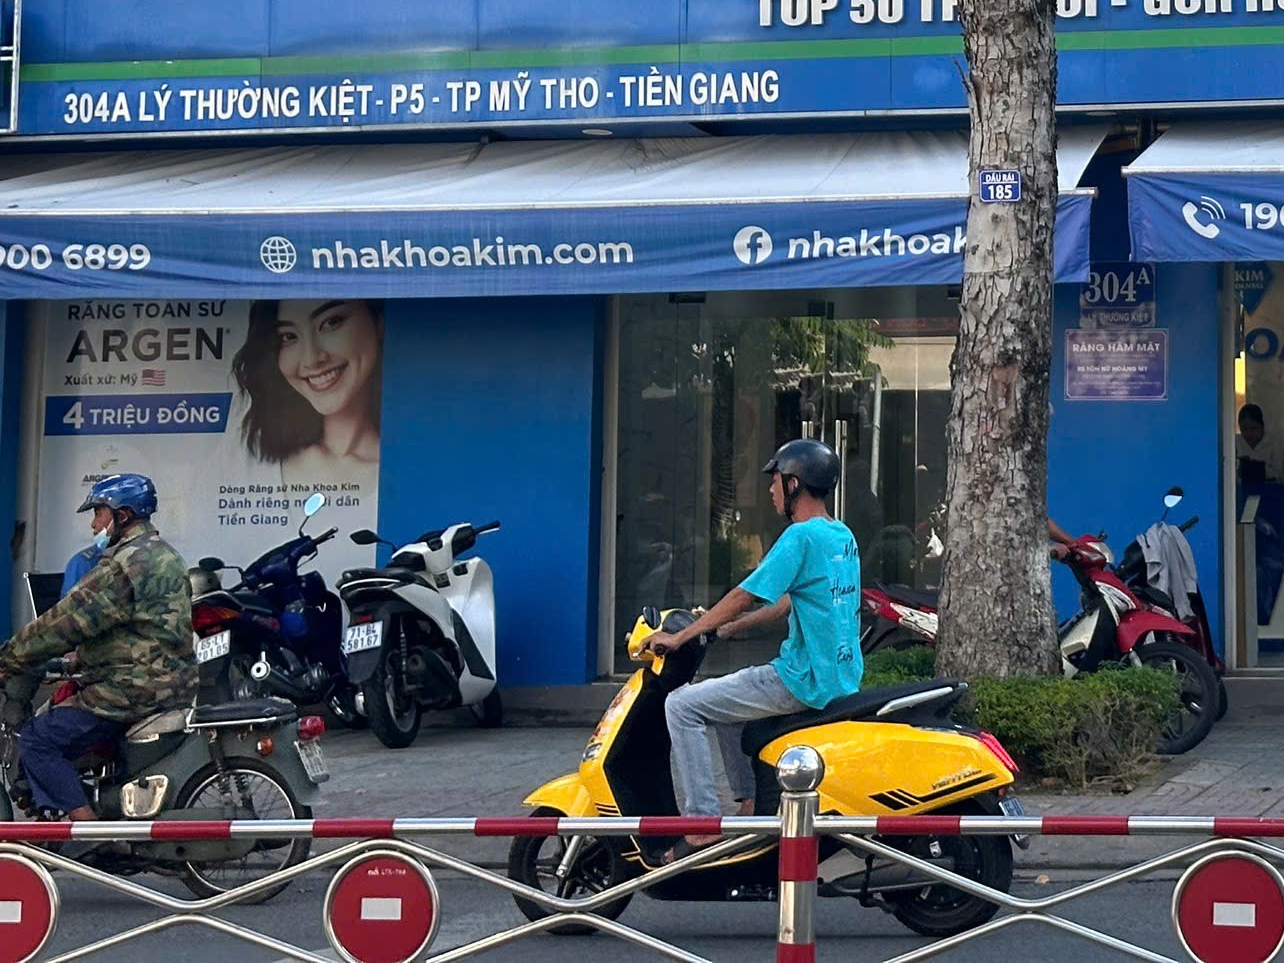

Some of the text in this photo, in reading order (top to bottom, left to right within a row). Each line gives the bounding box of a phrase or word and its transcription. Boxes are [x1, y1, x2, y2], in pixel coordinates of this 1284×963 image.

[64, 66, 780, 124] 304A LÝ THƯỜNG KIỆT P5 TP MỸ THO TIỀN GIANG
[988, 184, 1013, 199] 185
[787, 225, 967, 259] nhakhoak
[0, 244, 150, 270] 00 6899
[311, 236, 635, 270] nhakhoakim.com
[1235, 270, 1264, 281] KIM
[66, 327, 223, 363] ARGEN
[1072, 341, 1105, 353] RĂNG
[1108, 341, 1133, 352] HÀM
[120, 373, 138, 387] Mỹ
[63, 400, 220, 429] 4 TRIỆU ĐỒNG
[291, 484, 310, 492] Nha
[313, 483, 338, 492] Khoa
[341, 483, 360, 491] Kim
[218, 497, 251, 509] Dành
[256, 497, 289, 510] riêng
[336, 496, 360, 506] dân
[250, 514, 288, 526] Giang
